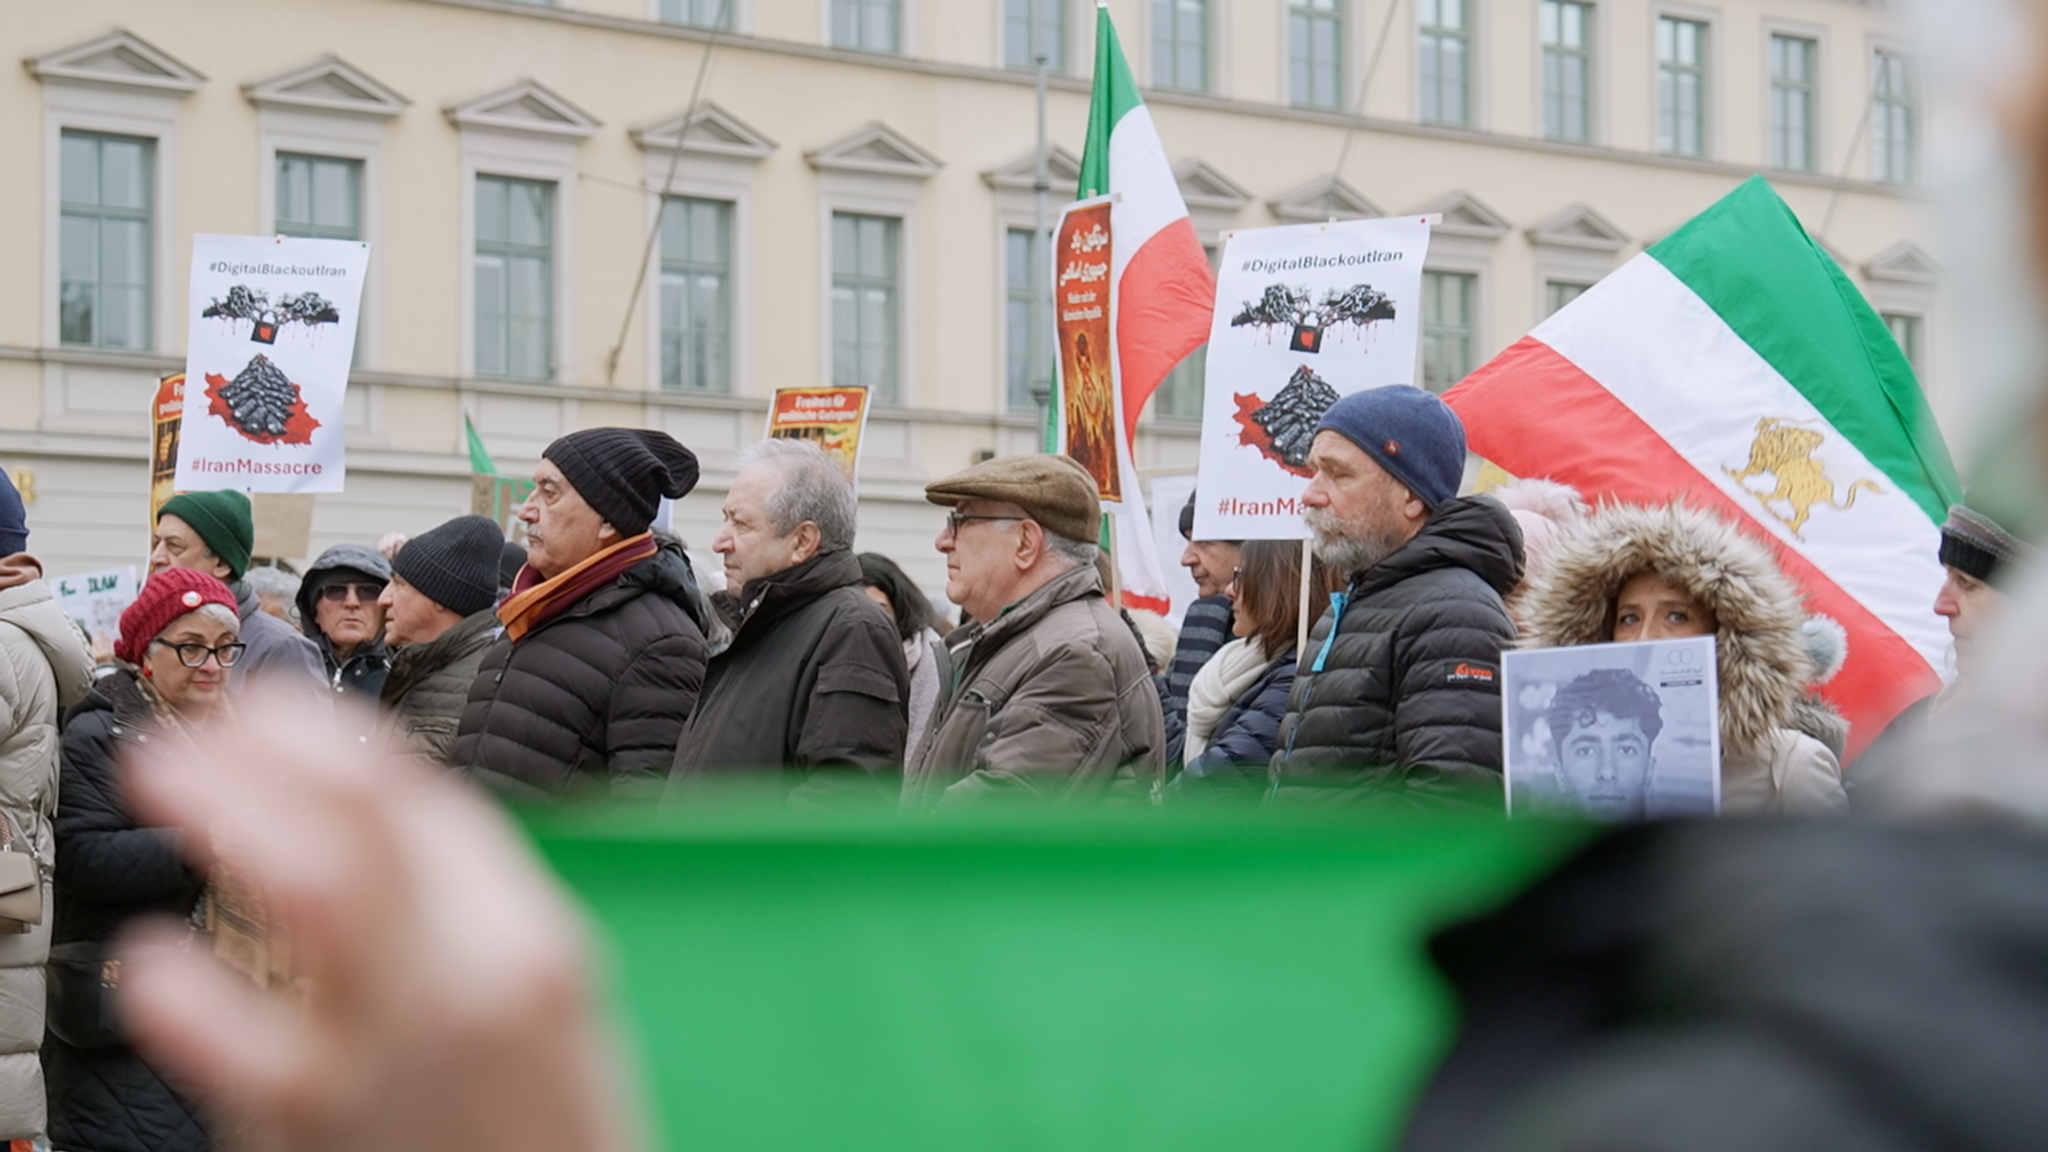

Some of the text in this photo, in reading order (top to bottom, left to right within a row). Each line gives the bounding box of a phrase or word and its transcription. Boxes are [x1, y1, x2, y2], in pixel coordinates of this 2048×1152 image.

[209, 261, 347, 277] #DigitalBlackoutIran
[1241, 250, 1403, 275] #DigitalBlackoutIran
[191, 458, 323, 475] #IranMassacre
[1217, 497, 1308, 516] #IranMa
